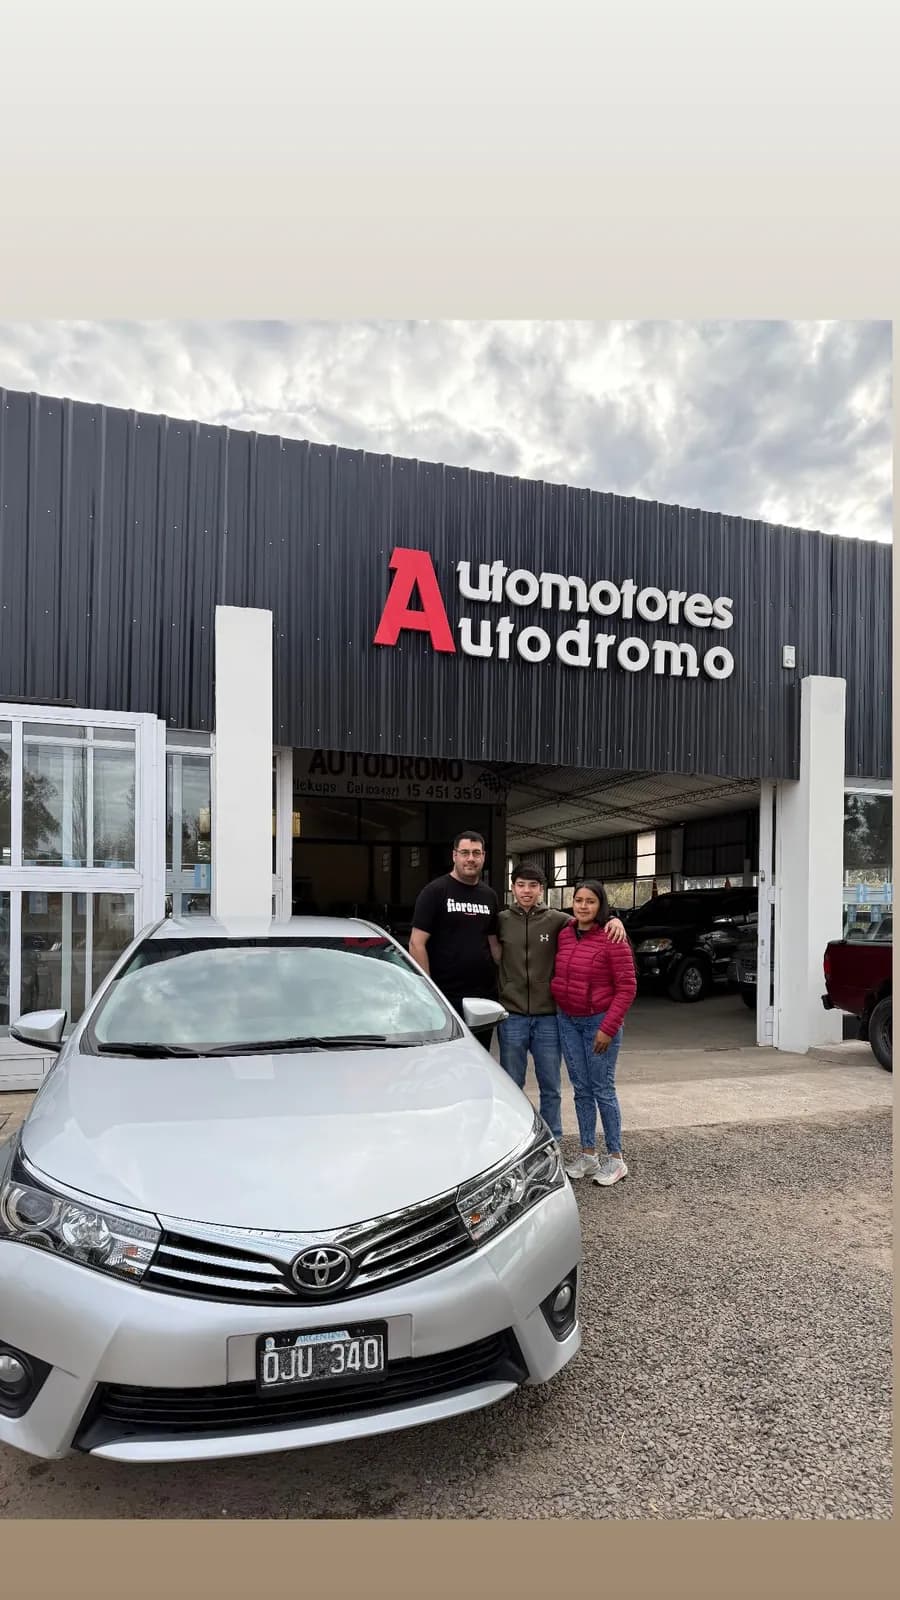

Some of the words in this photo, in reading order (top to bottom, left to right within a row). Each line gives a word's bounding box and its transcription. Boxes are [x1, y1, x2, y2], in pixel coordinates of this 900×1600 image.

[307, 750, 464, 782] AUTODROMO
[293, 778, 337, 794] ickups
[346, 781, 364, 794] Cel
[407, 784, 421, 797] 15
[425, 785, 449, 799] 451
[453, 786, 482, 800] 359
[297, 1331, 347, 1343] ARGENTINA
[263, 1347, 313, 1383] OJU
[330, 1338, 379, 1373] 340
